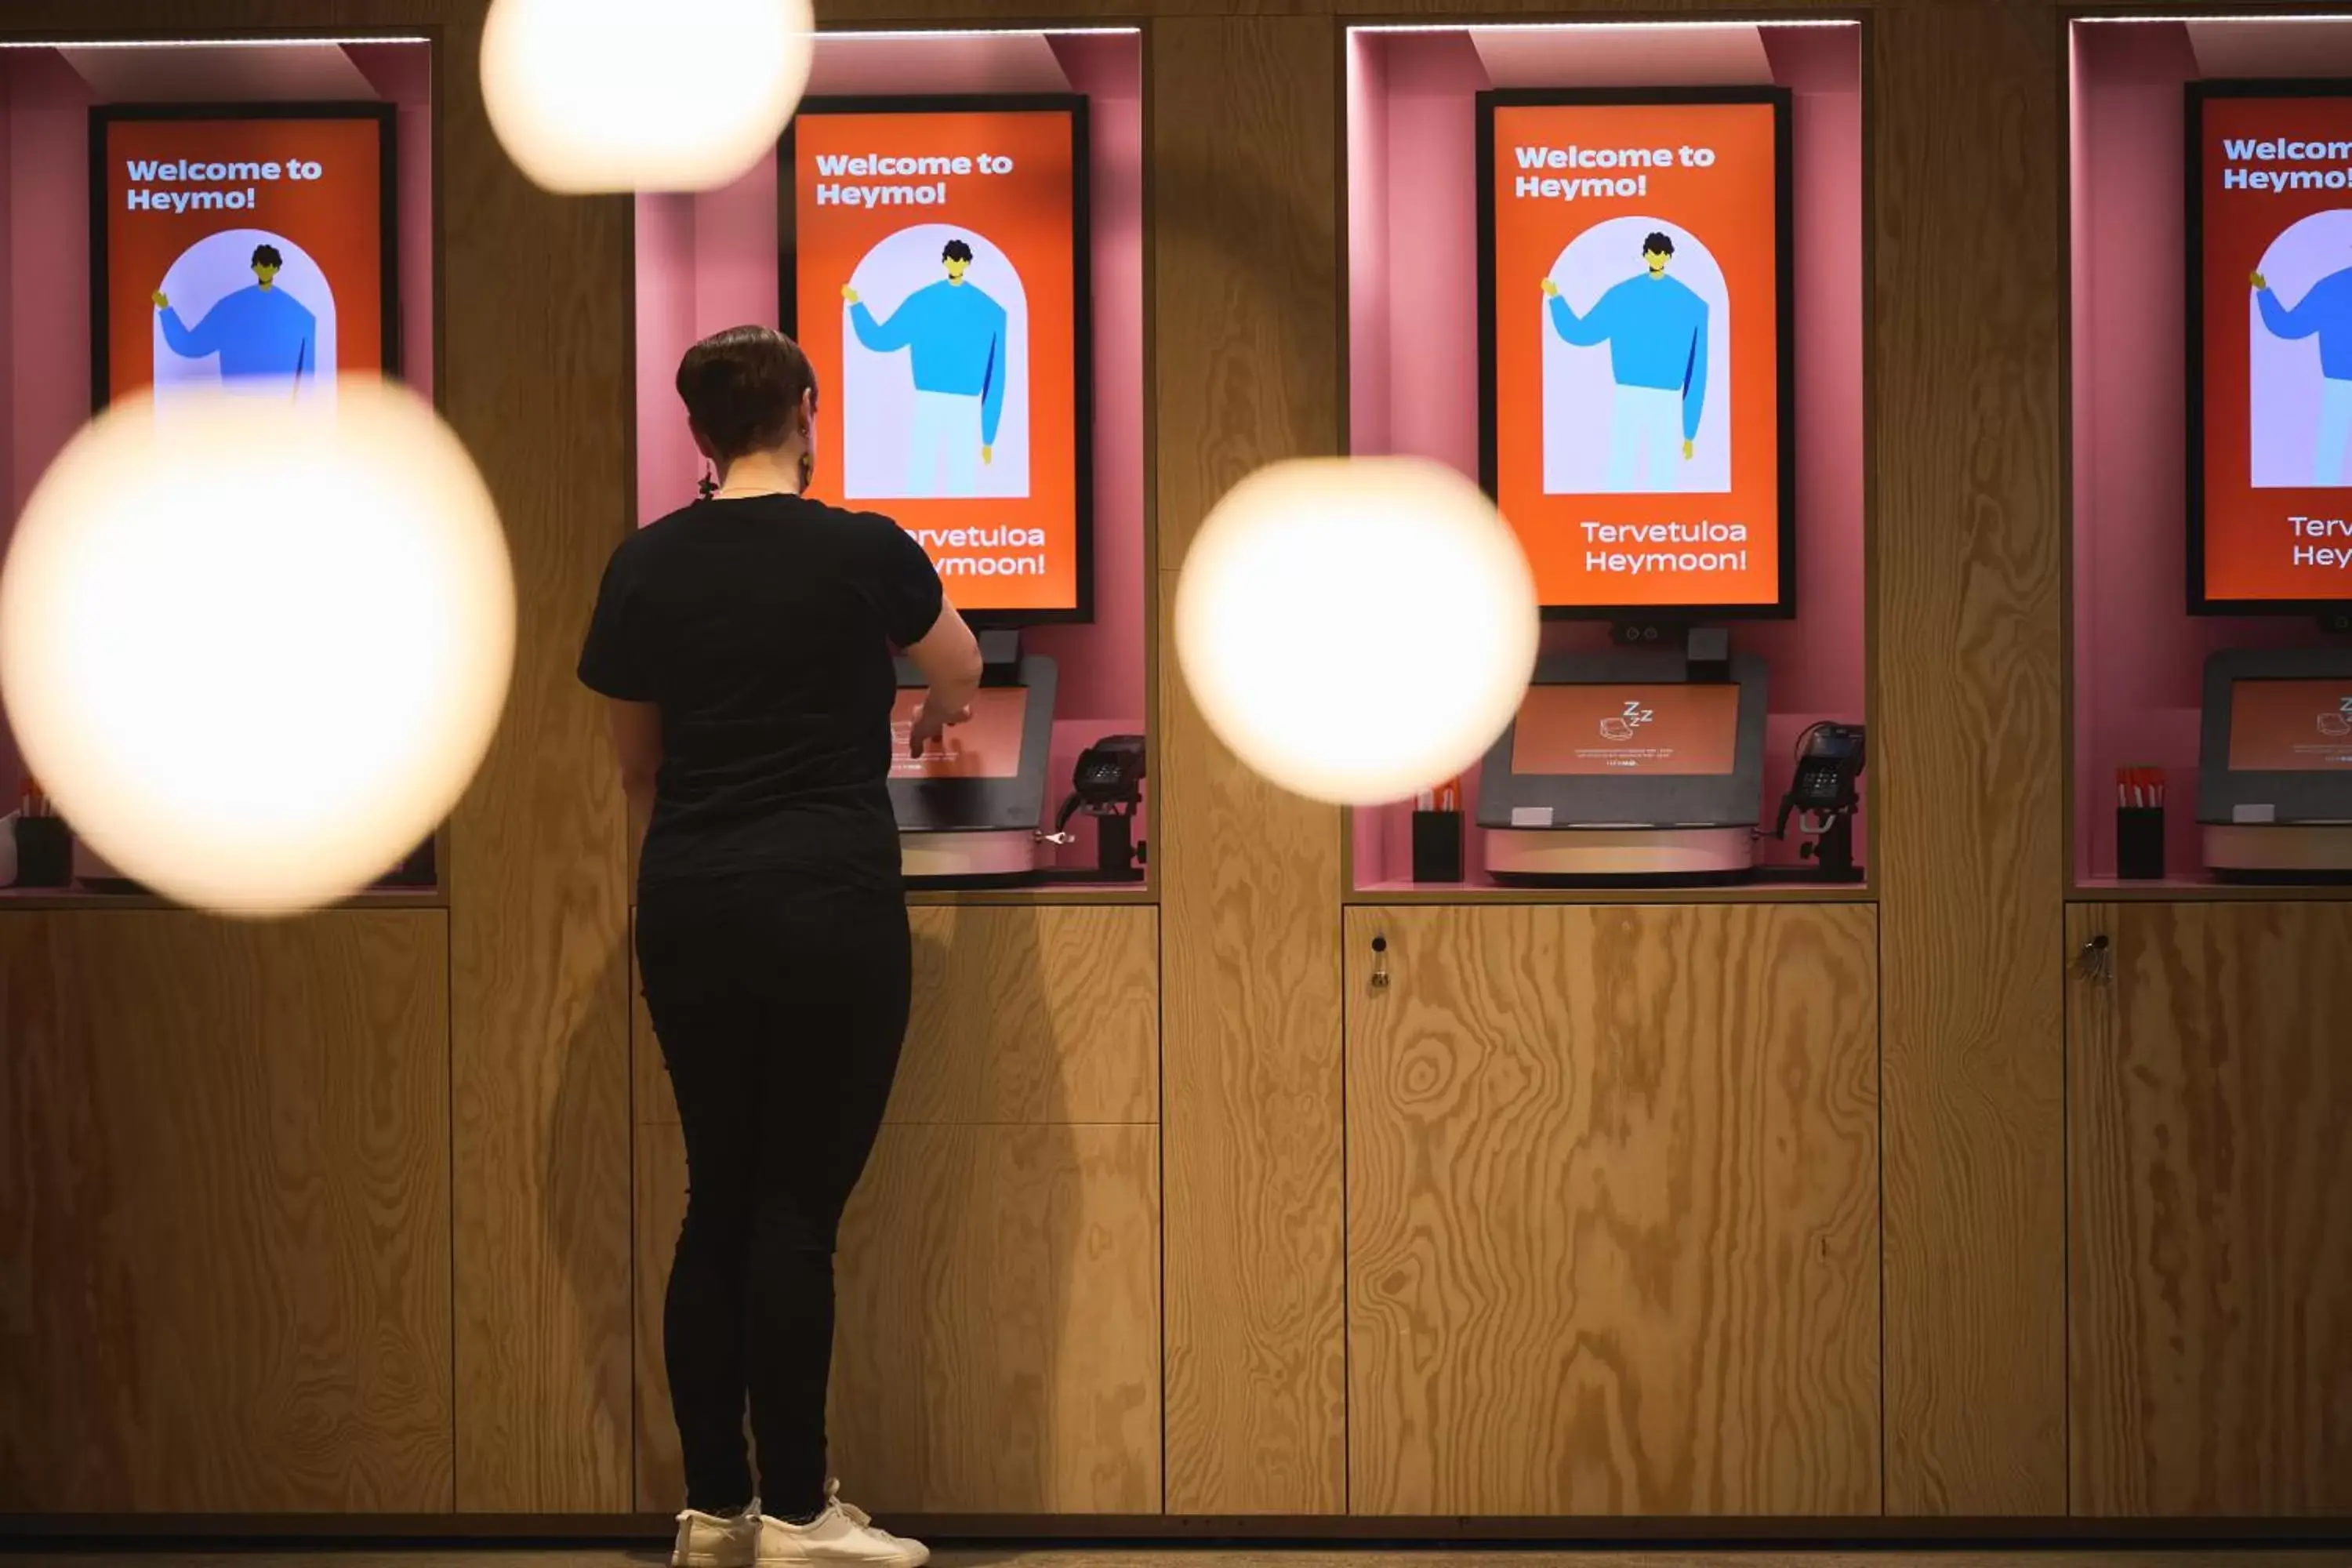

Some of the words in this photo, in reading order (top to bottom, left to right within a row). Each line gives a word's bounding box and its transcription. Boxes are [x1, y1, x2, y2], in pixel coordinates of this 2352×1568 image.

[1515, 146, 1672, 169] Welcome
[1679, 146, 1715, 167] to
[2223, 138, 2352, 160] Welcom
[127, 160, 281, 181] Welcome
[286, 159, 321, 180] to
[816, 154, 972, 176] Welcome
[977, 154, 1013, 174] to
[817, 182, 946, 209] Heymo!
[1516, 176, 1646, 201] Heymo!
[128, 188, 254, 213] Heymo!
[905, 525, 1044, 547] rvetuloa
[1581, 521, 1747, 543] Tervetuloa
[2288, 517, 2352, 536] Terv
[933, 554, 1044, 575] ymoon!
[1586, 550, 1745, 575] Heymoon!
[2294, 546, 2352, 568] Hey
